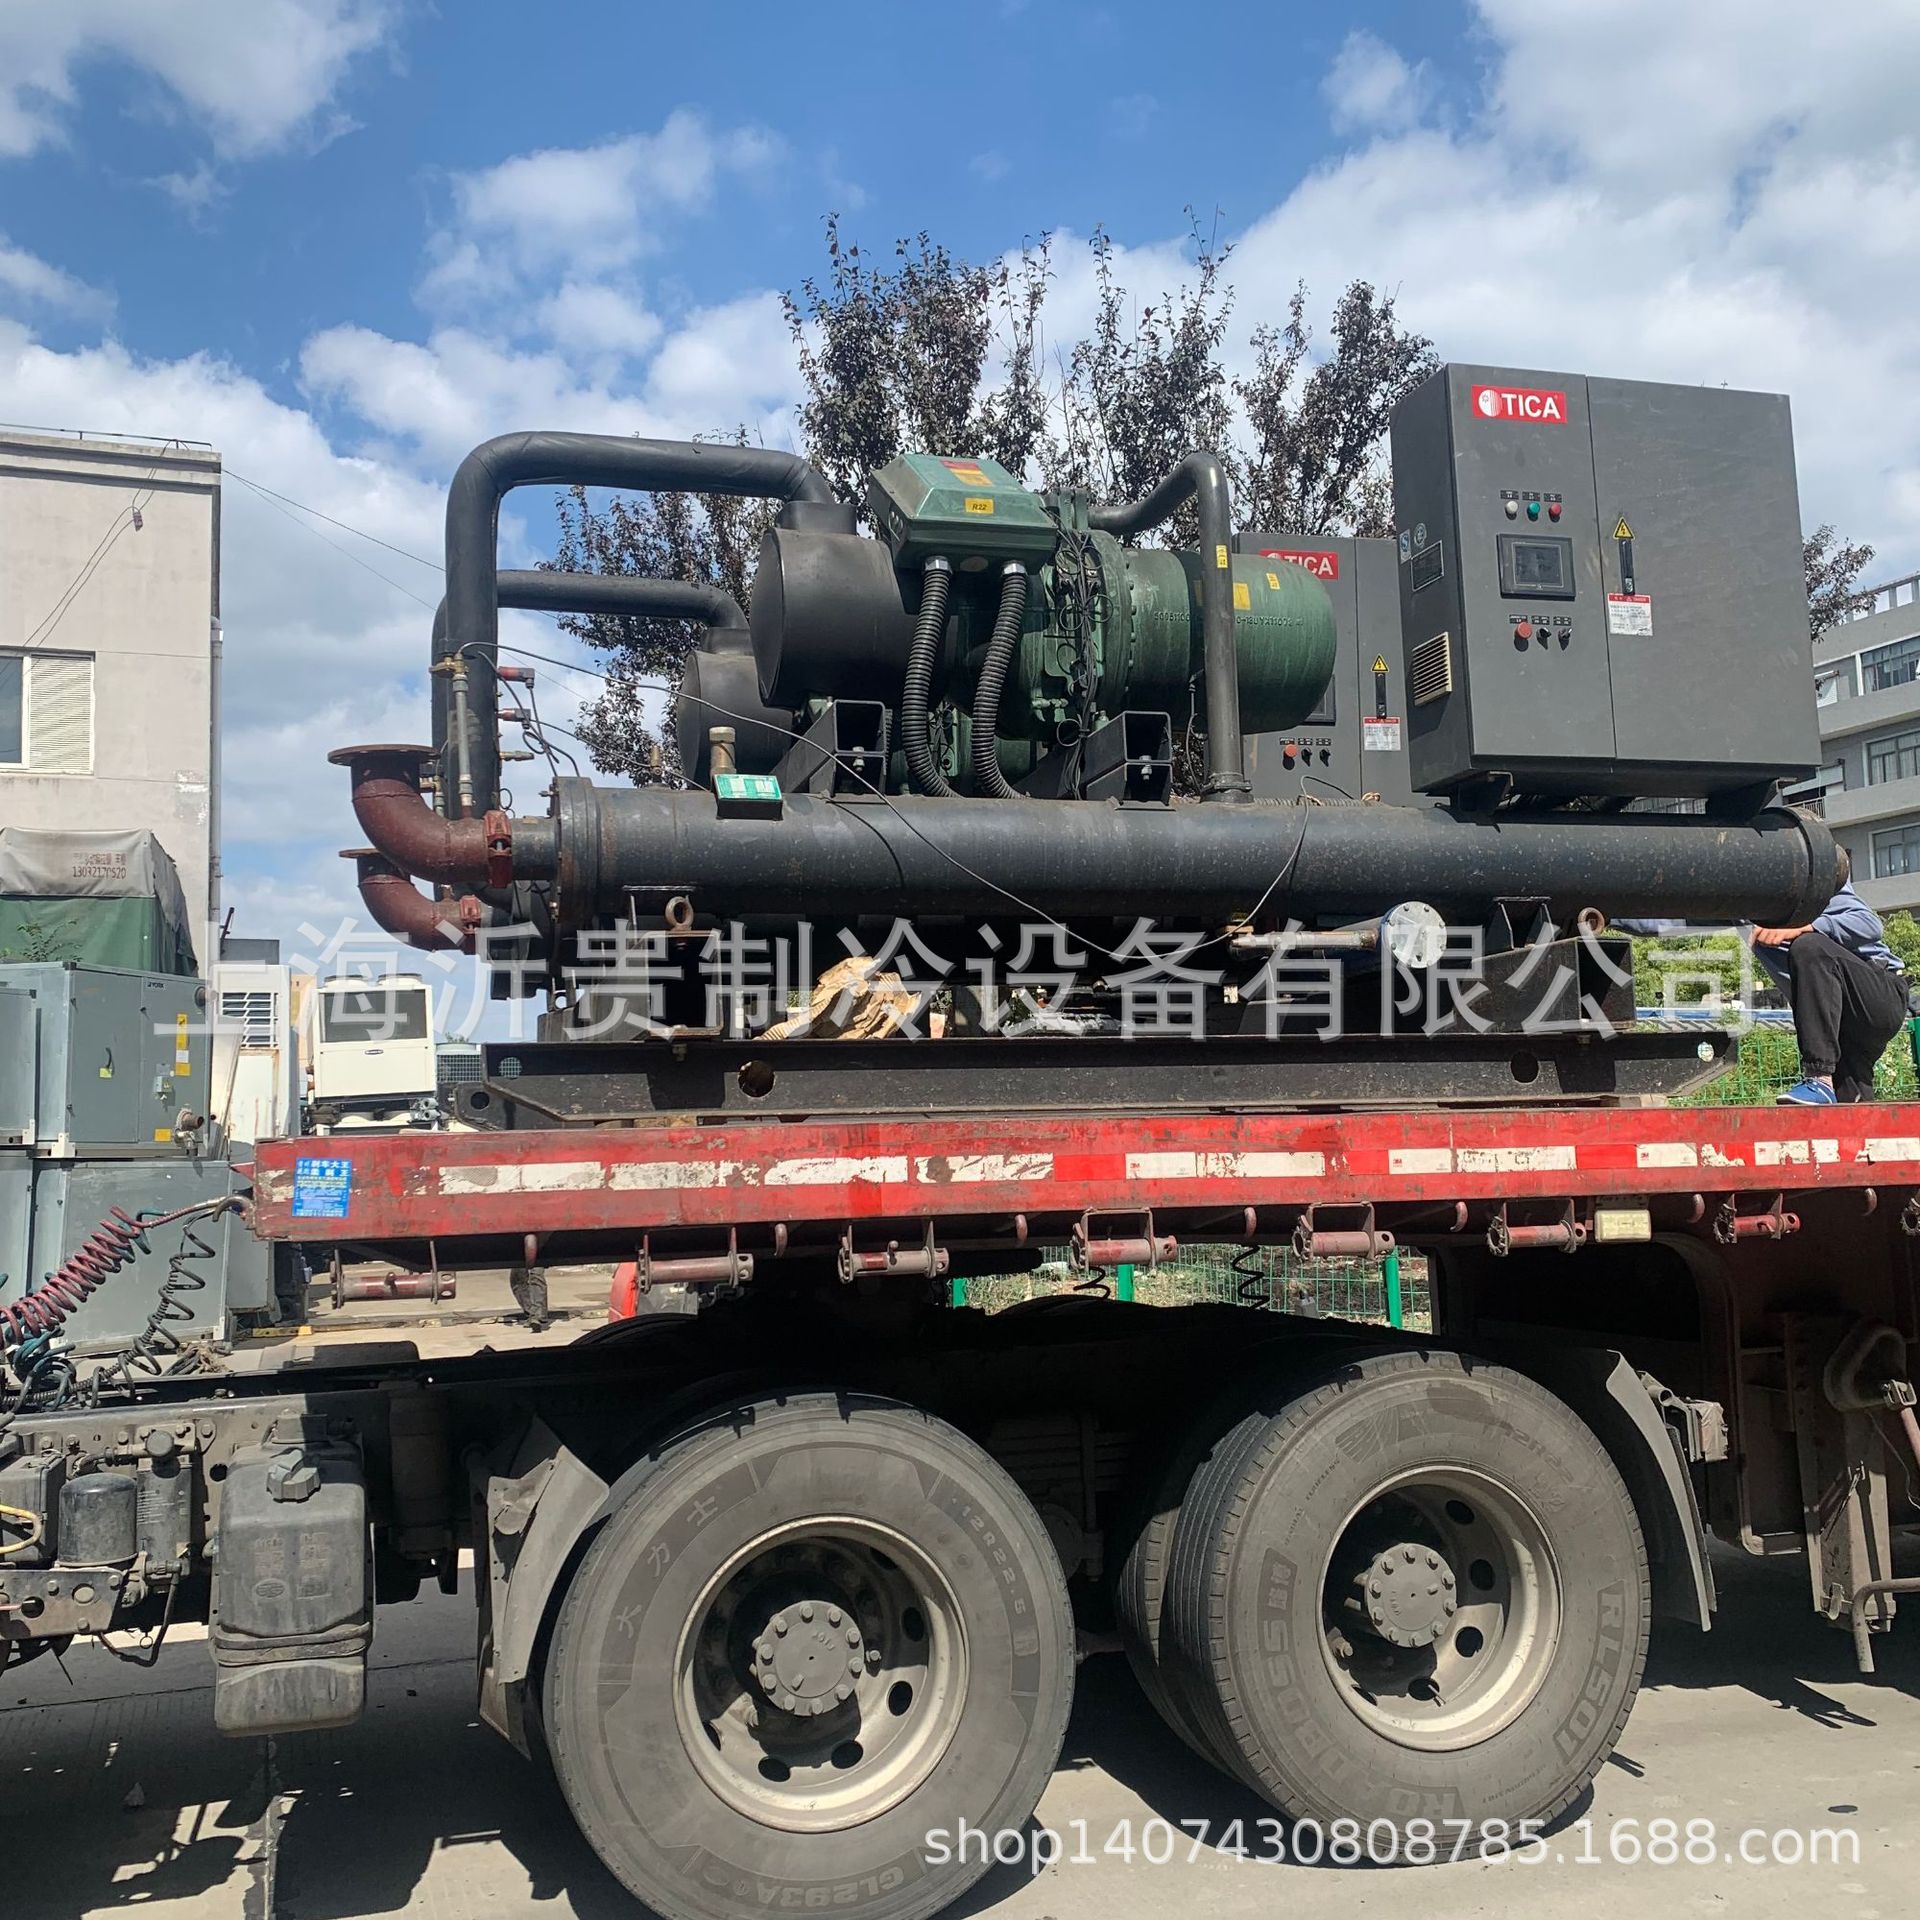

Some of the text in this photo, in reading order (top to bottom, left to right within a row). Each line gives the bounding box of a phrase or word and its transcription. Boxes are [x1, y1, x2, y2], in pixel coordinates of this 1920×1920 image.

[1500, 393, 1561, 419] TICA
[614, 1495, 719, 1640] 大力士
[961, 1505, 1027, 1615] 12R22.5
[1263, 1620, 1457, 1820] RODBOSS
[1557, 1592, 1624, 1757] RL501
[756, 1865, 906, 1909] GL293A
